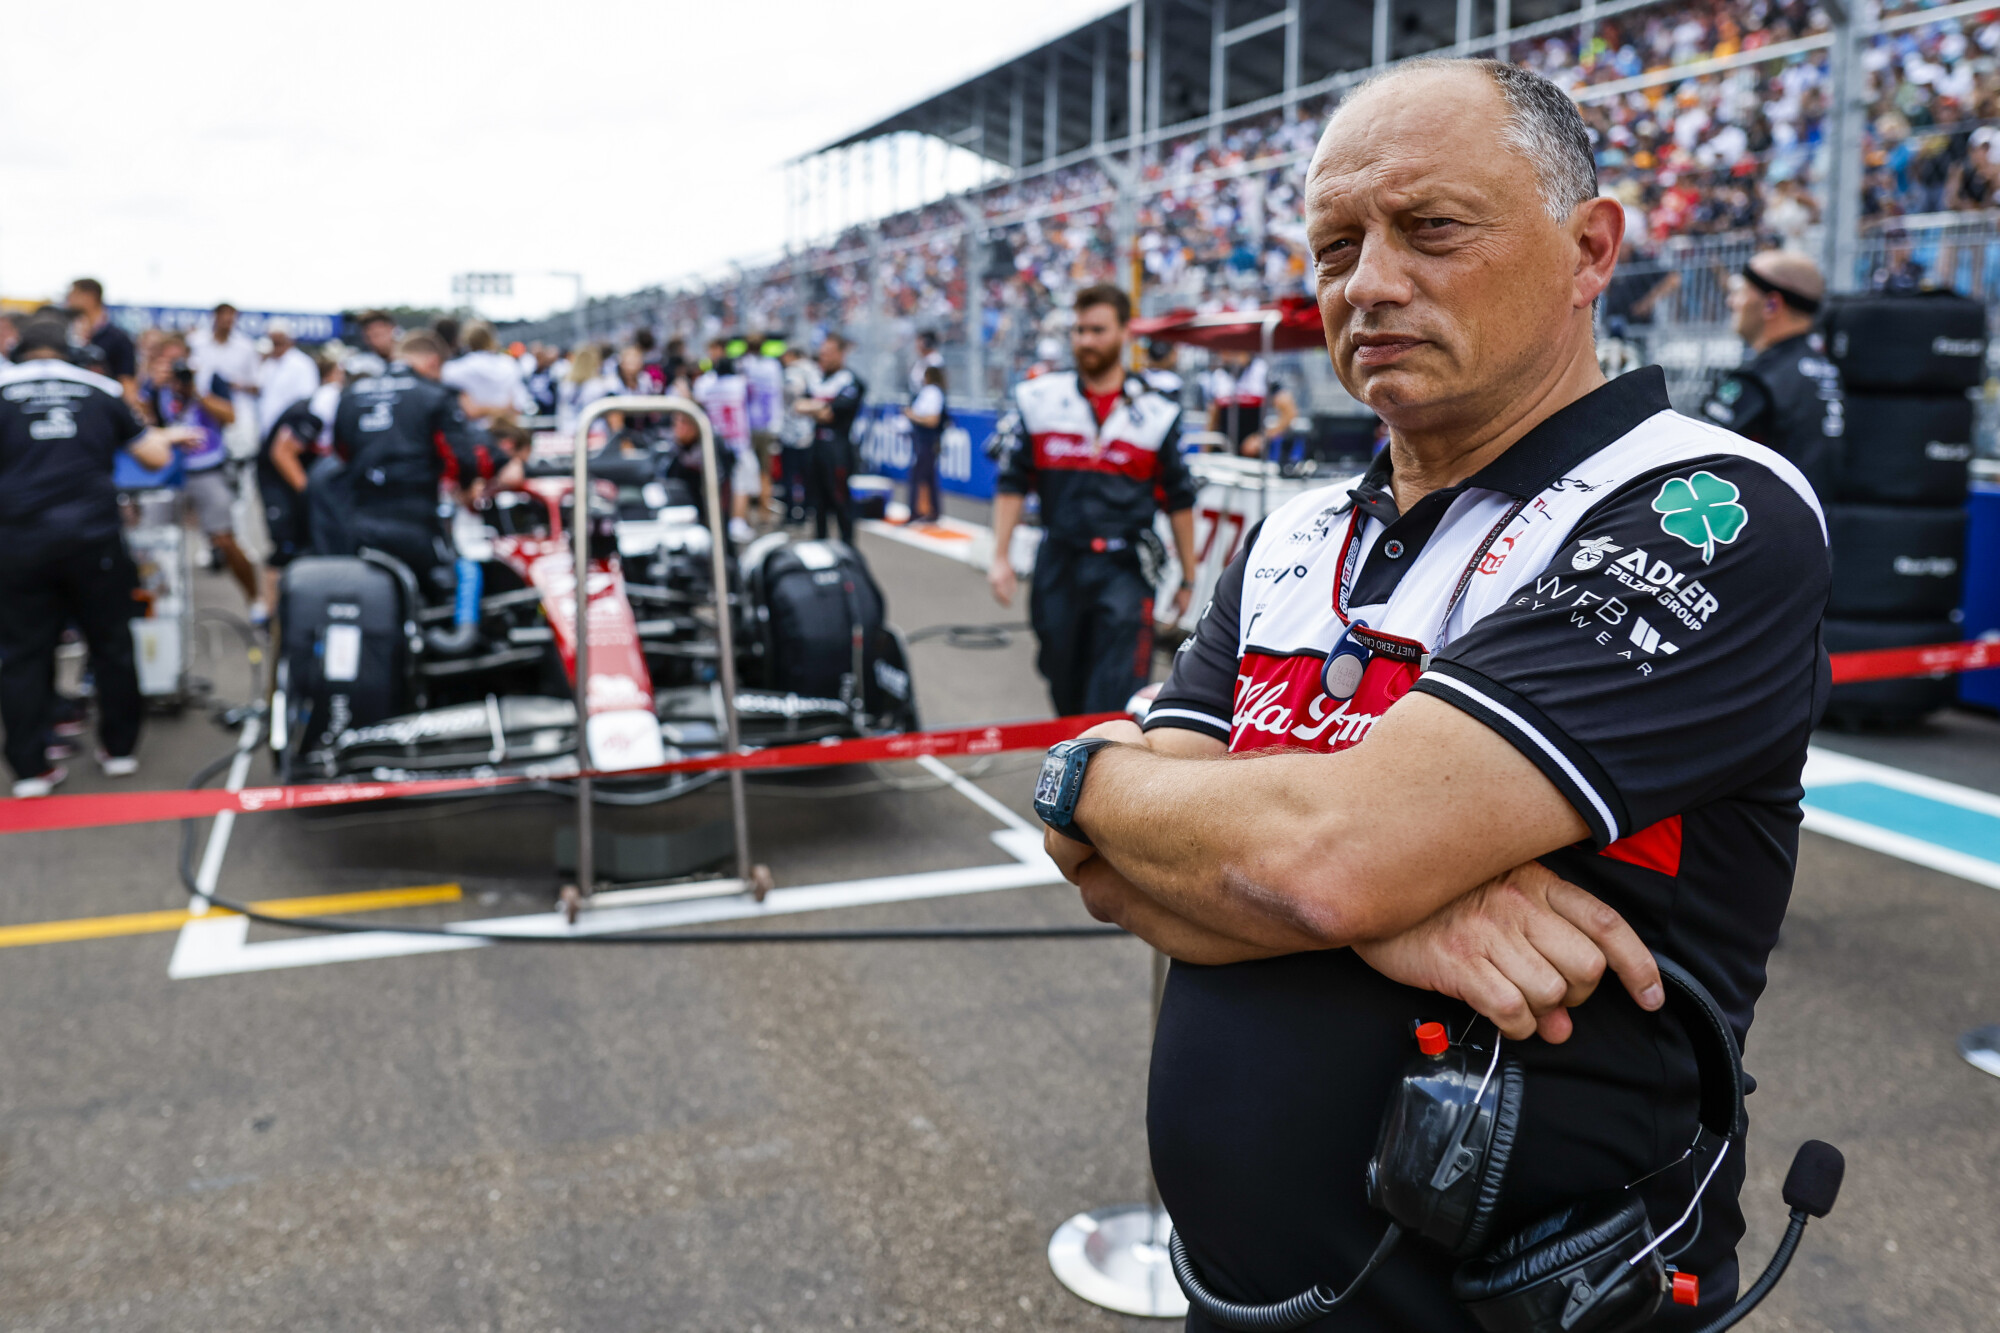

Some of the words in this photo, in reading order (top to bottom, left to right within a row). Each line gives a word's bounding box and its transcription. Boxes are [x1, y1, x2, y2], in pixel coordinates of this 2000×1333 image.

[1346, 536, 1360, 566] 2022
[1455, 570, 1472, 597] FROM
[1470, 526, 1502, 568] RECYCLED
[1500, 500, 1522, 525] PLASTI
[1343, 566, 1351, 583] PIT
[1615, 547, 1719, 623] ADLER
[1339, 585, 1350, 615] GRID
[1604, 563, 1661, 596] PELZER
[1657, 592, 1703, 631] GROUP
[1351, 630, 1375, 648] CARBO
[1376, 640, 1396, 654] ZERO
[1396, 645, 1416, 657] NET
